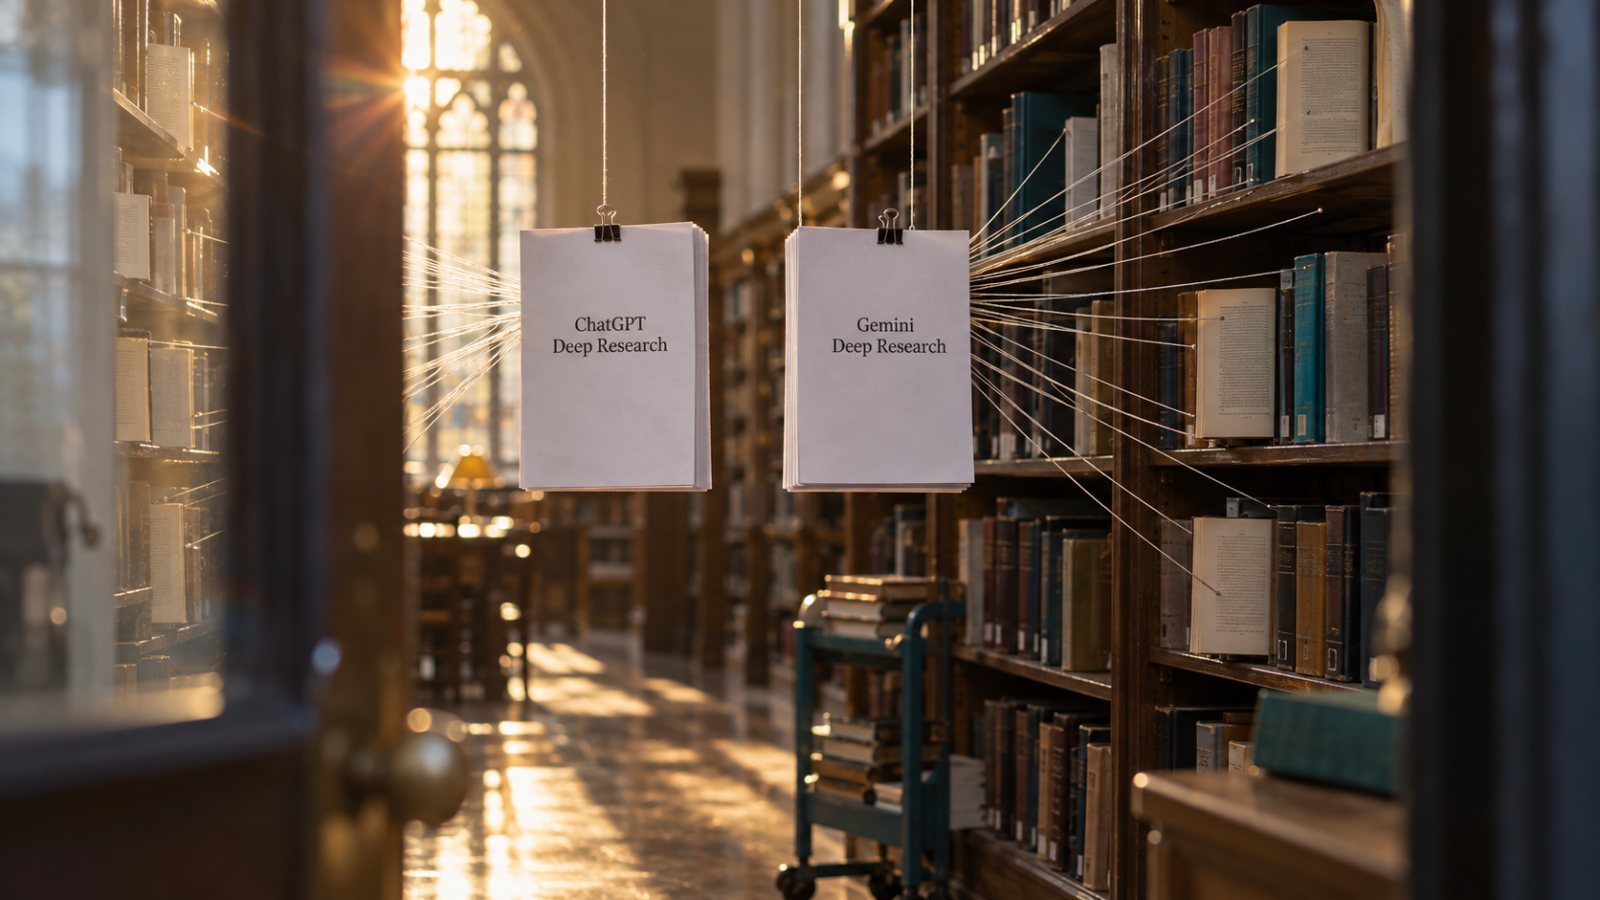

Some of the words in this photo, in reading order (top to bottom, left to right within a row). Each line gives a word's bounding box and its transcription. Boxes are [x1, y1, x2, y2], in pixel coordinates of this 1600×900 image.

[574, 316, 647, 333] ChatGPT
[856, 316, 915, 333] Gemini
[552, 338, 593, 357] Deep
[597, 336, 668, 354] Research
[832, 338, 873, 357] Deep
[876, 338, 947, 354] Research
